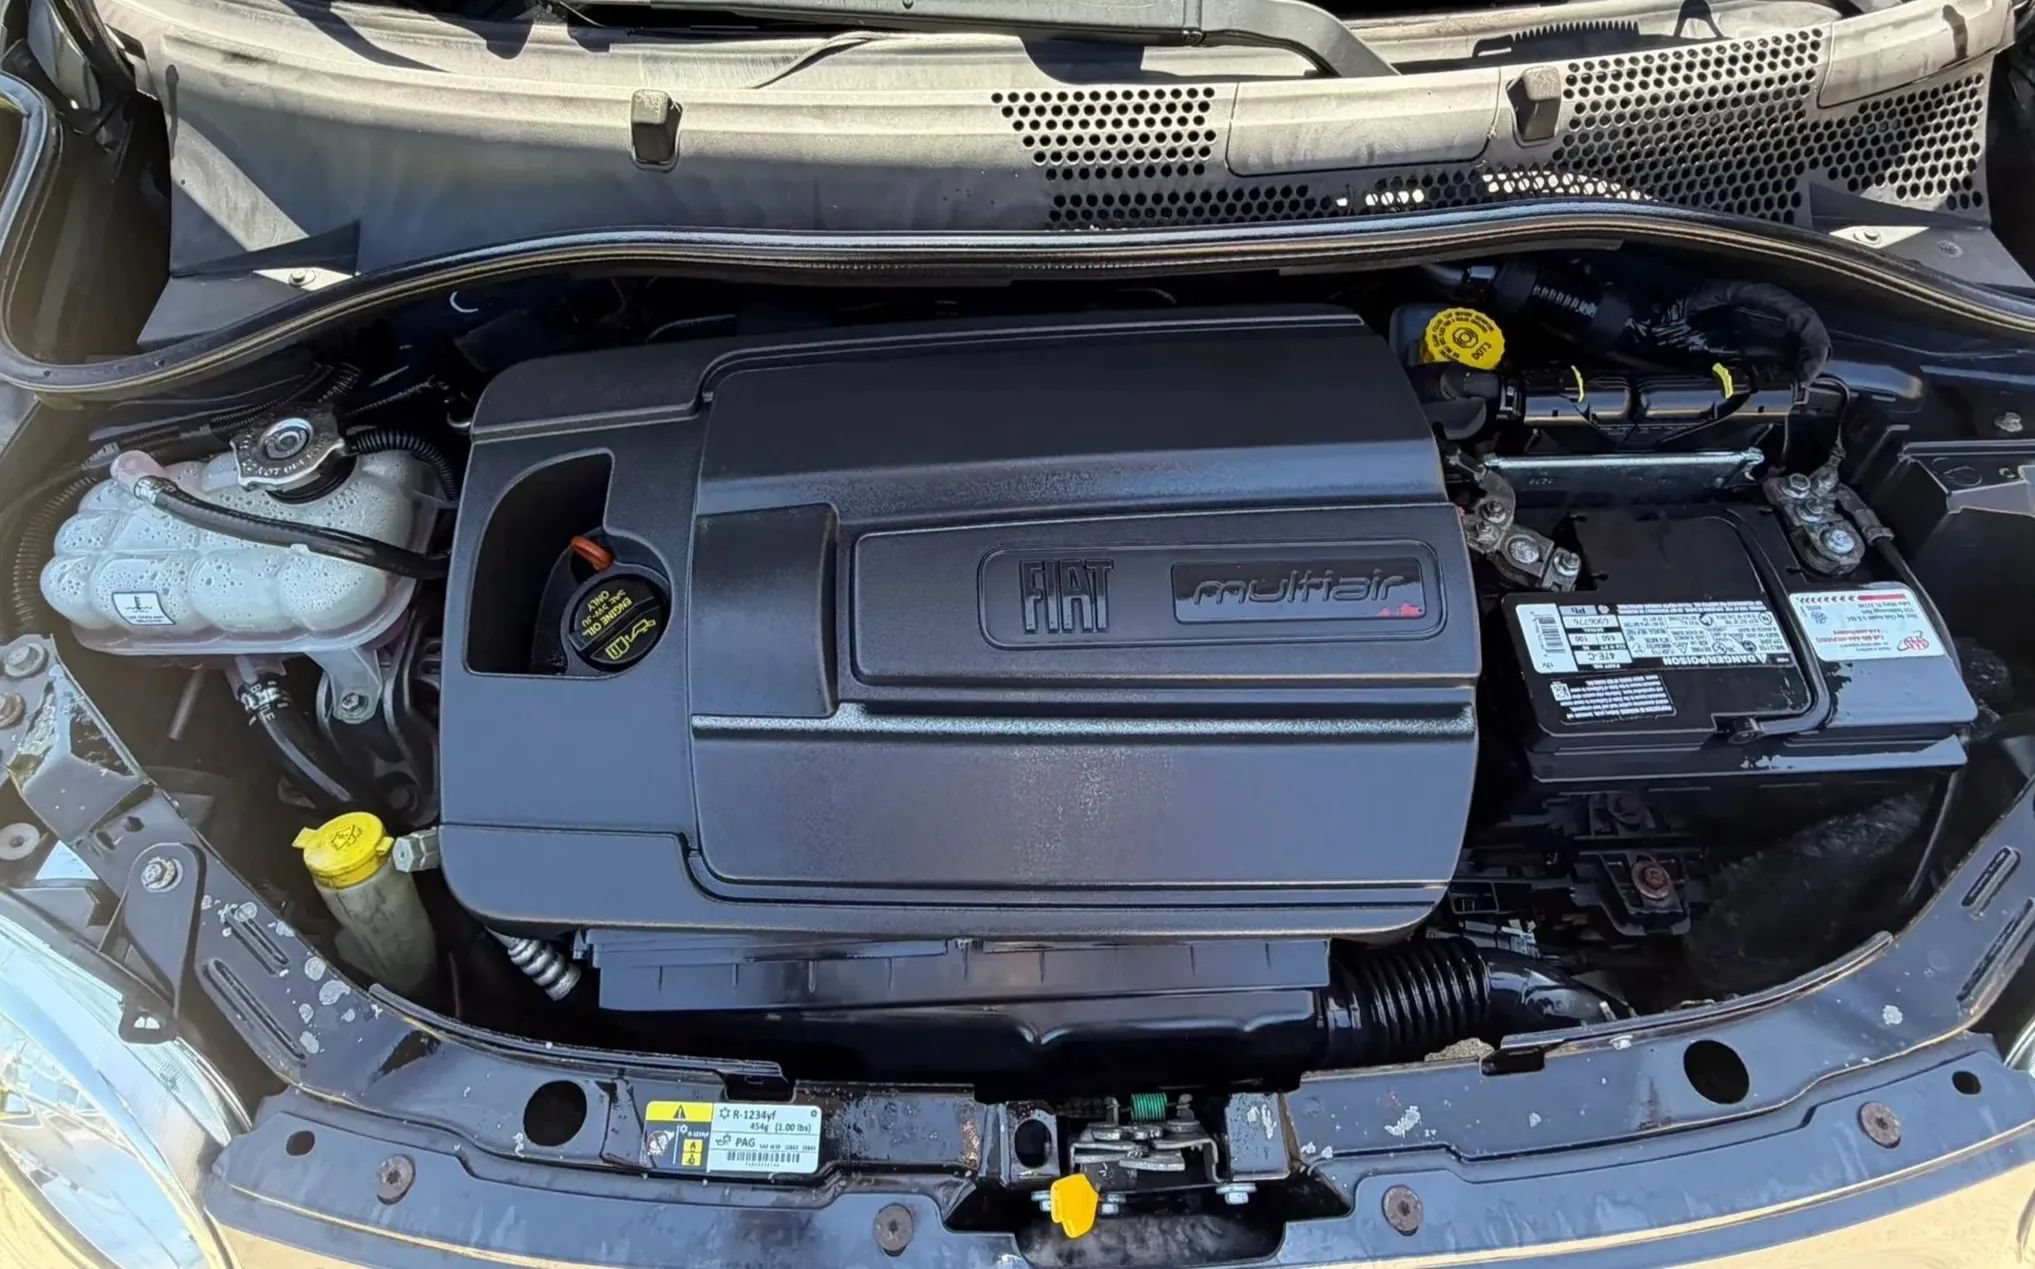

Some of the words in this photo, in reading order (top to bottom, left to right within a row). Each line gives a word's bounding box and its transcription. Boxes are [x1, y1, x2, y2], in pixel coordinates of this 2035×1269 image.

[1193, 568, 1405, 606] multiair
[587, 590, 610, 612] ONLY
[1018, 558, 1115, 634] FIAT
[600, 596, 632, 625] ENGINE
[1571, 607, 1586, 615] Pb
[582, 622, 602, 636] OIL
[1587, 652, 1616, 661] 47E-C
[1662, 653, 1757, 666] DANGER/POISON
[733, 1109, 776, 1122] R-1234yf
[750, 1122, 769, 1132] 454g
[775, 1122, 795, 1133] (1.00
[797, 1123, 811, 1133] lbs)
[735, 1137, 756, 1148] PAG
